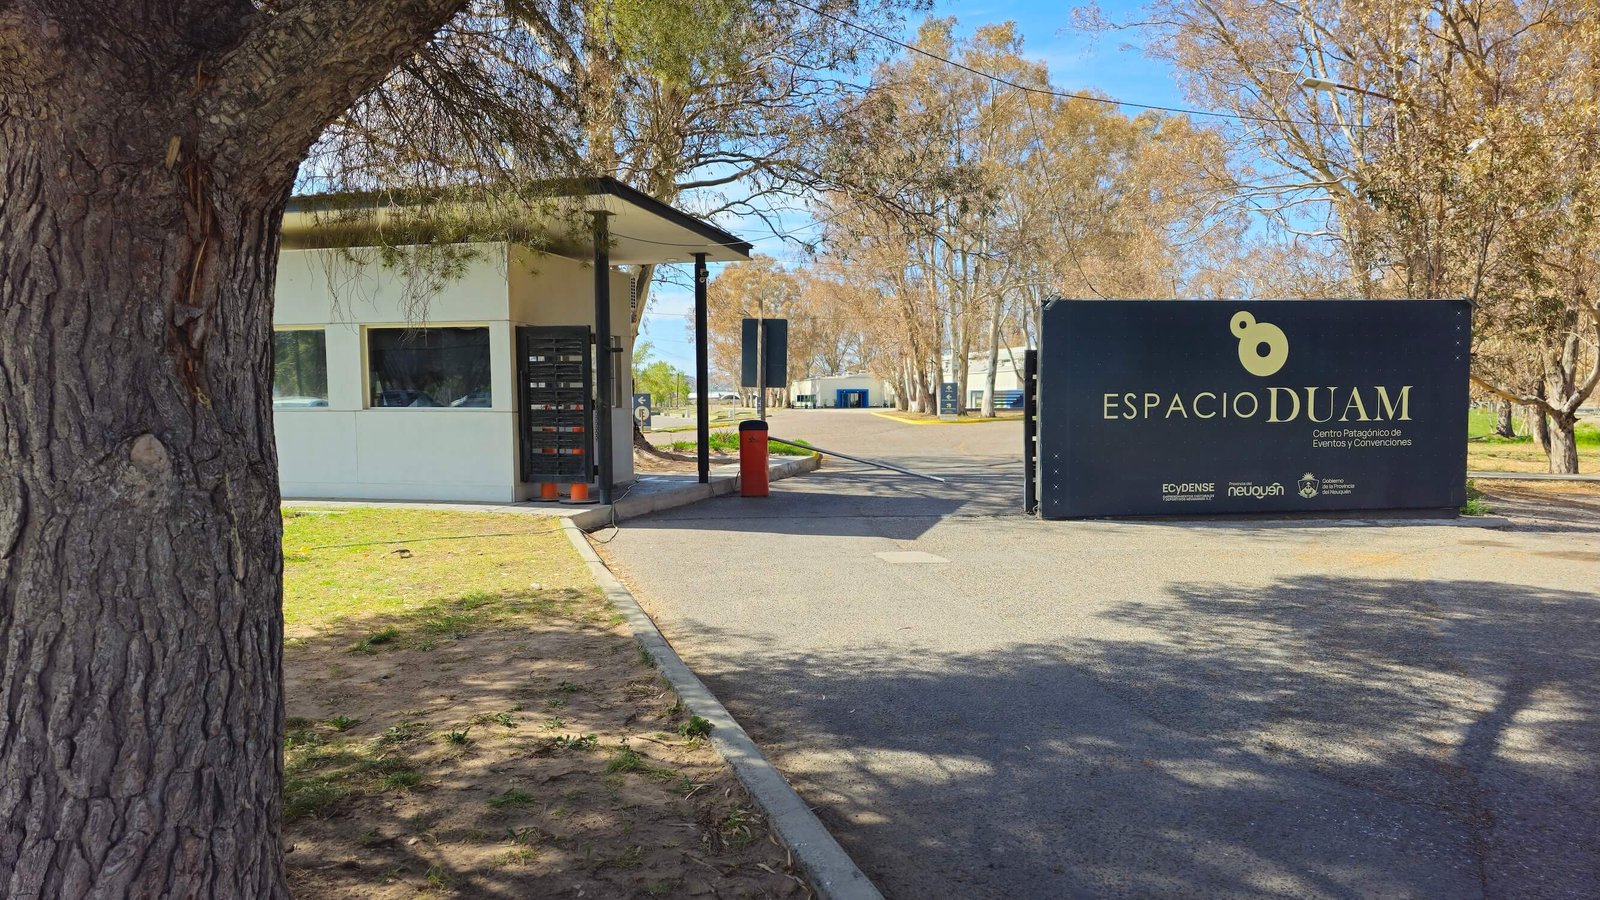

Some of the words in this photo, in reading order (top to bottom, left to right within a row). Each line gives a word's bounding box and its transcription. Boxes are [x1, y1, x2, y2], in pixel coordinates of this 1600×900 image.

[1103, 391, 1258, 420] ESPACIO
[1266, 385, 1413, 423] DUAM
[1312, 429, 1342, 438] Centro
[1343, 428, 1390, 439] Patagónico
[1390, 428, 1402, 437] de
[1312, 439, 1346, 448] Eventos
[1347, 440, 1353, 449] y
[1353, 438, 1412, 447] Convenciones
[1162, 482, 1215, 495] ECyDENSE
